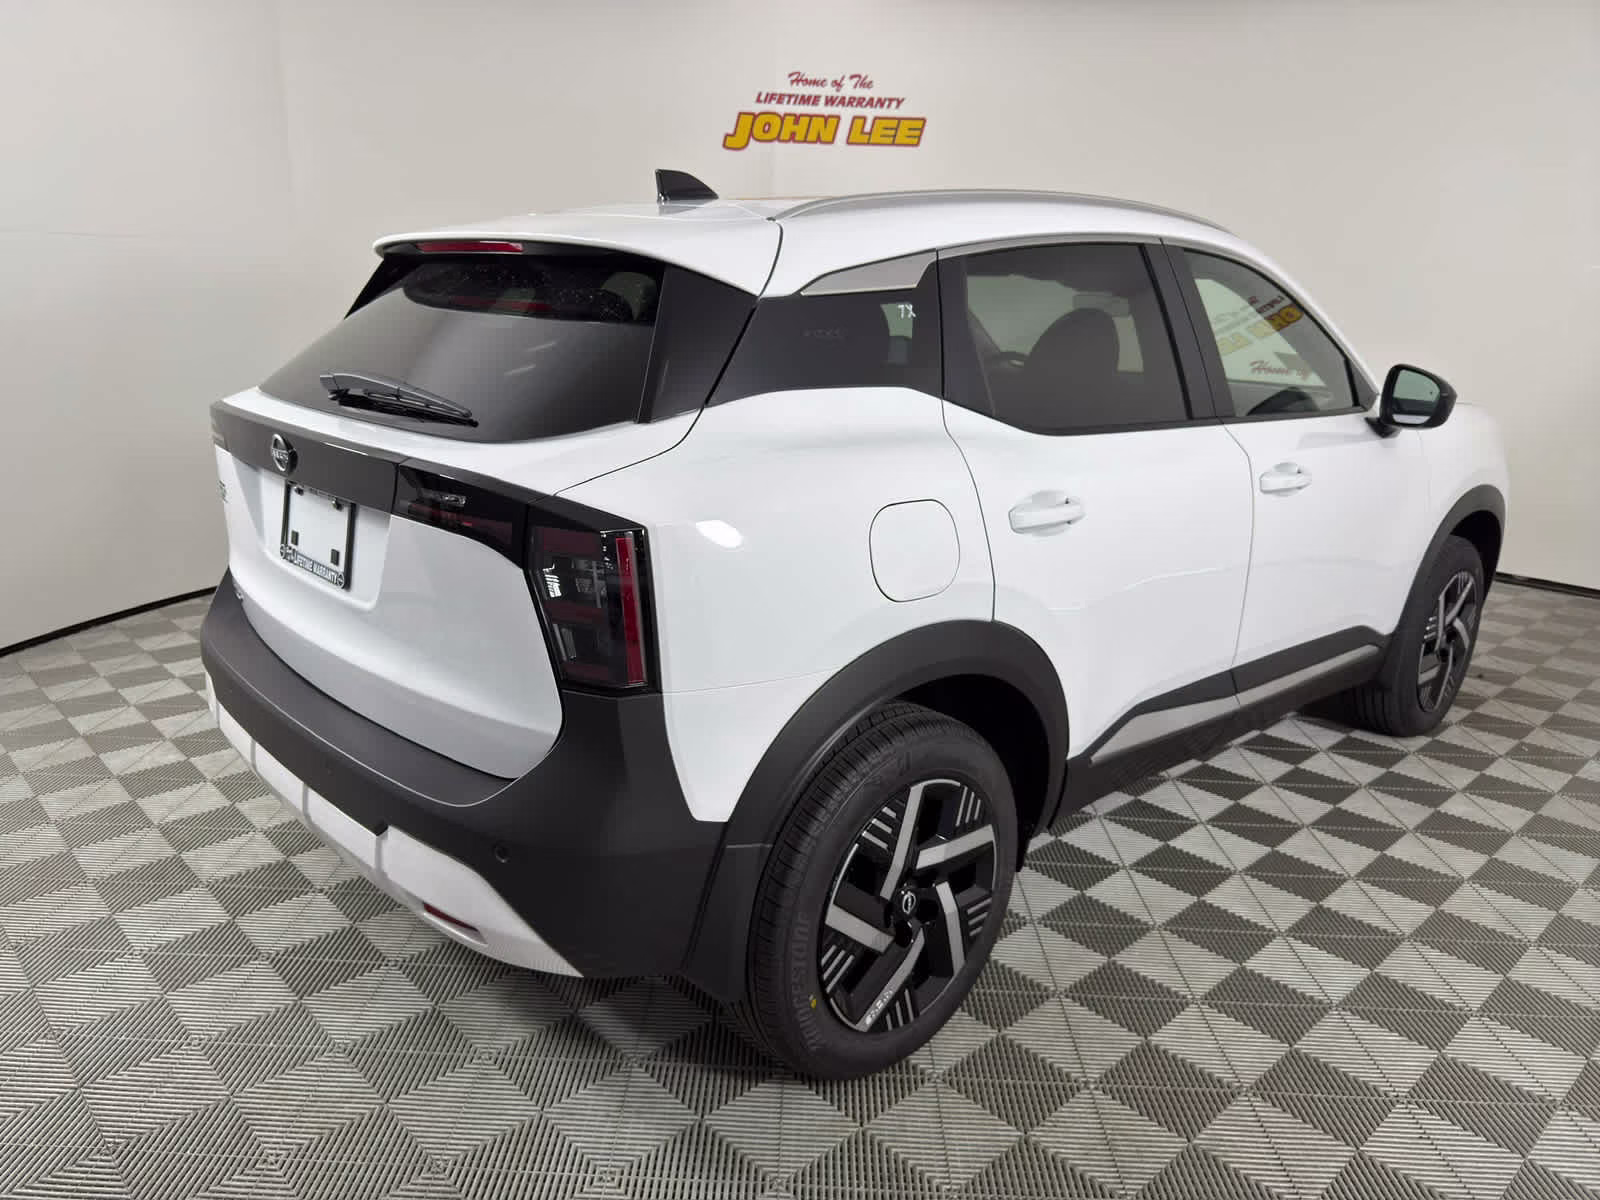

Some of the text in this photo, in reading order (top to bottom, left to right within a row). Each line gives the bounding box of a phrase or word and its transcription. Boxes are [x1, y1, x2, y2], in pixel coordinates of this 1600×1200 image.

[788, 71, 874, 91] Home of The
[755, 92, 904, 109] LIFETIME WARRANTY
[722, 111, 926, 150] JOHN LEE
